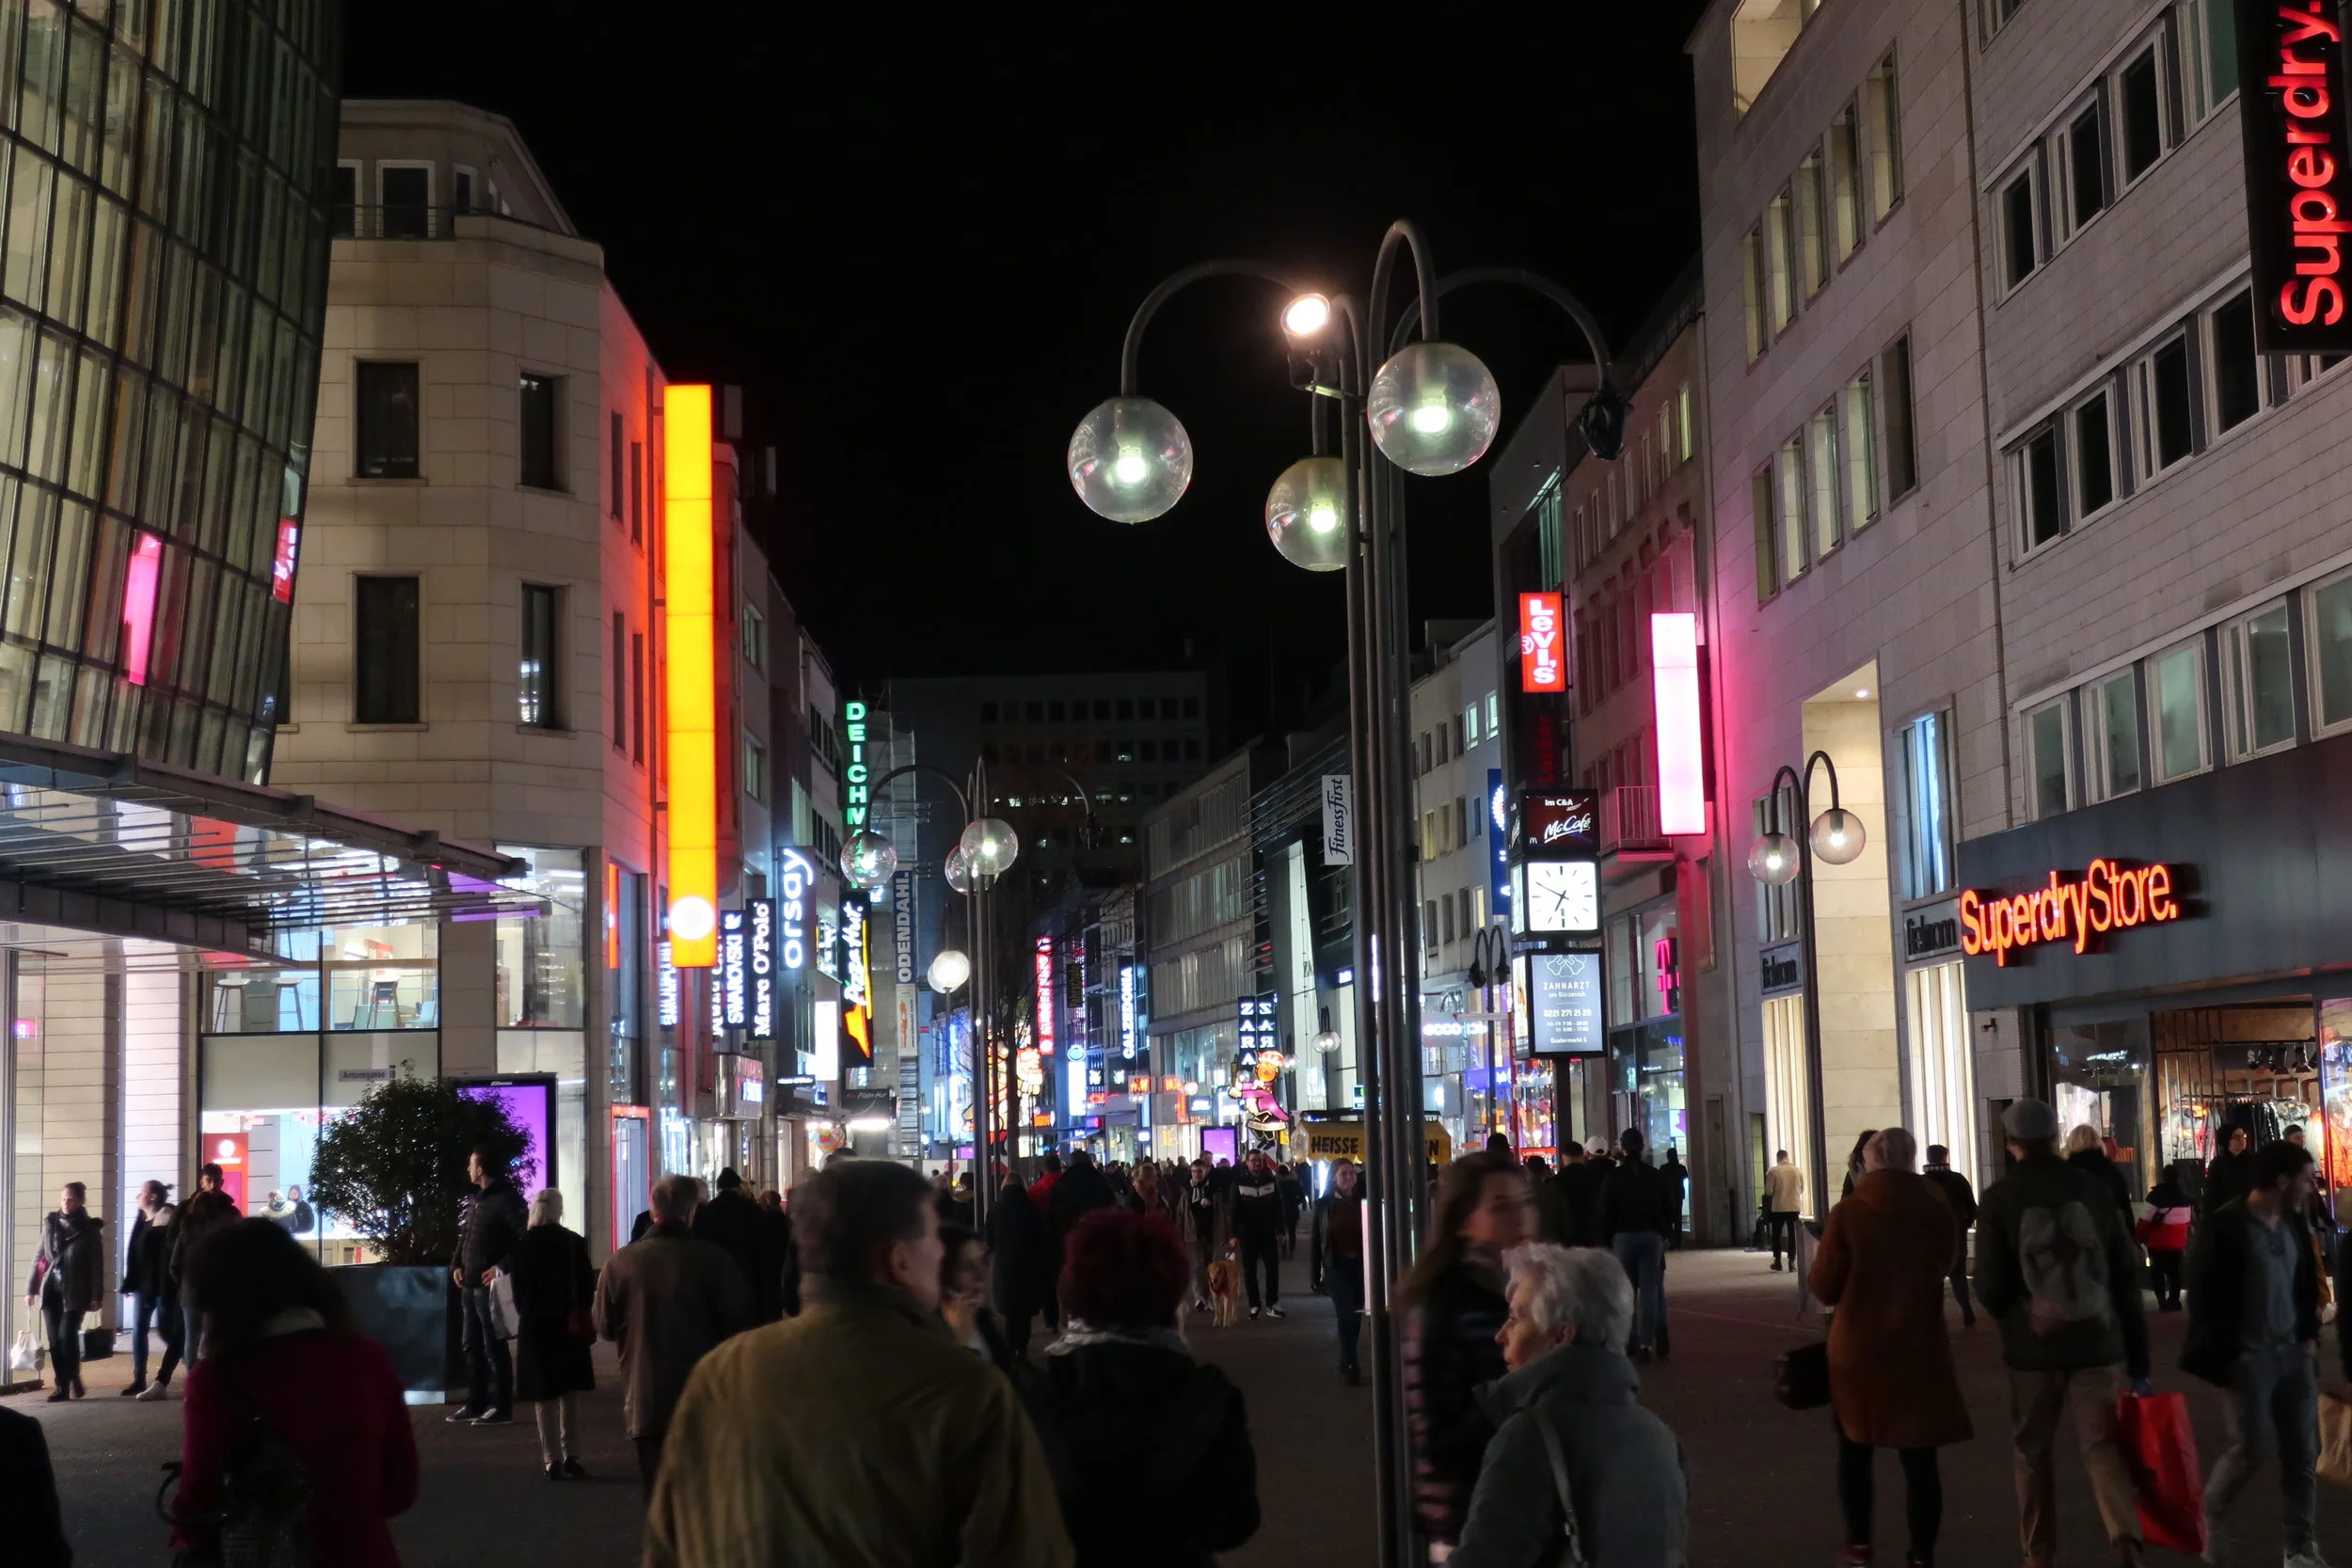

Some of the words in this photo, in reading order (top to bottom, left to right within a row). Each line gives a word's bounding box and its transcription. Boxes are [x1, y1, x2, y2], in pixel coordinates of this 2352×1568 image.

[847, 702, 867, 889] DEICHMA
[783, 848, 815, 969] orsay
[725, 934, 744, 1024] SWAROVSKI
[755, 979, 771, 1037] Marc
[1543, 981, 1591, 990] ZAHNARZT
[1239, 1003, 1257, 1066] ZARA
[1543, 1009, 1560, 1018] 0221
[1311, 1135, 1359, 1155] HEISSE
